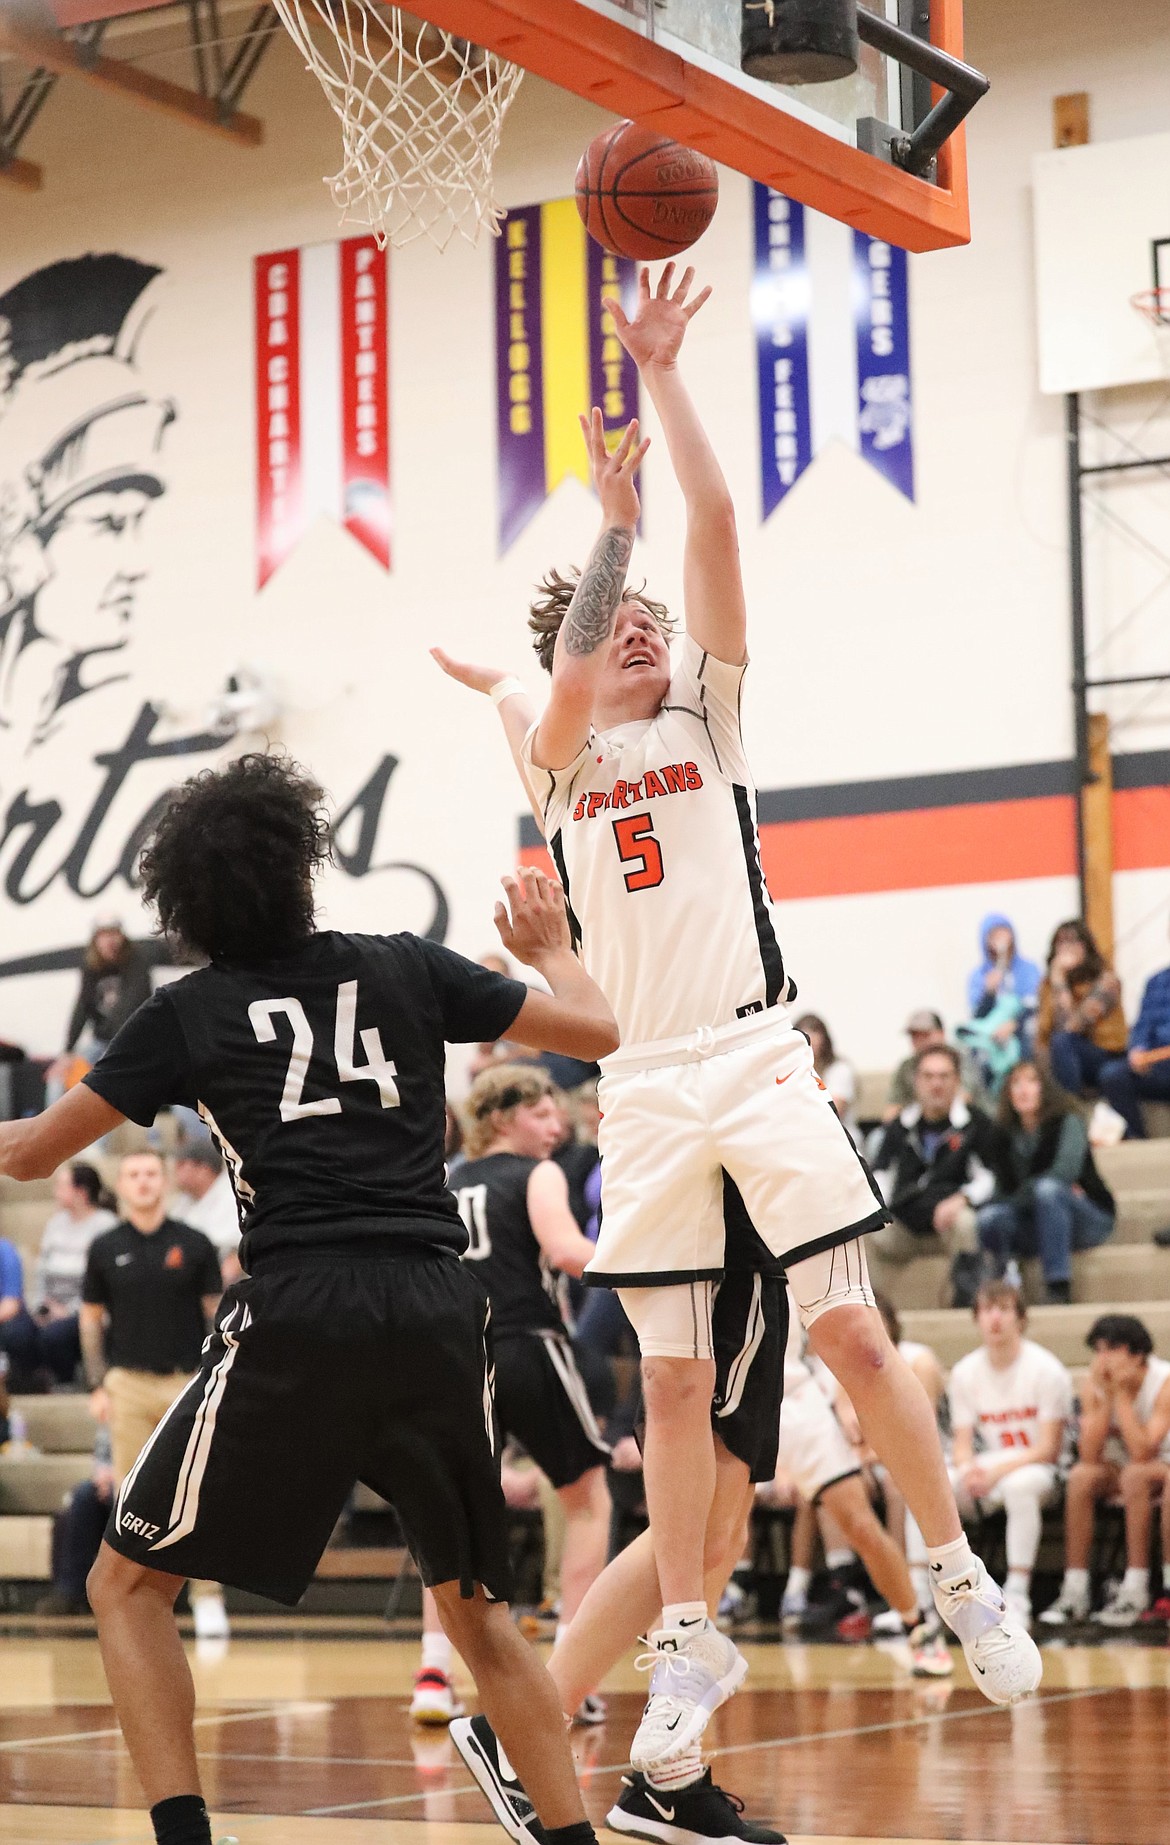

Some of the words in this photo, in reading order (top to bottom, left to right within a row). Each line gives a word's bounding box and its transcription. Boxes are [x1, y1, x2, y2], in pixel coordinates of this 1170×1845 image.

[268, 263, 288, 346] CDA
[355, 248, 377, 456] PANTHERS
[507, 219, 532, 435] KELLOGG
[774, 358, 797, 485] FERRY
[612, 812, 664, 893] 5
[248, 979, 401, 1123] 24
[121, 1511, 160, 1540] GRIZ
